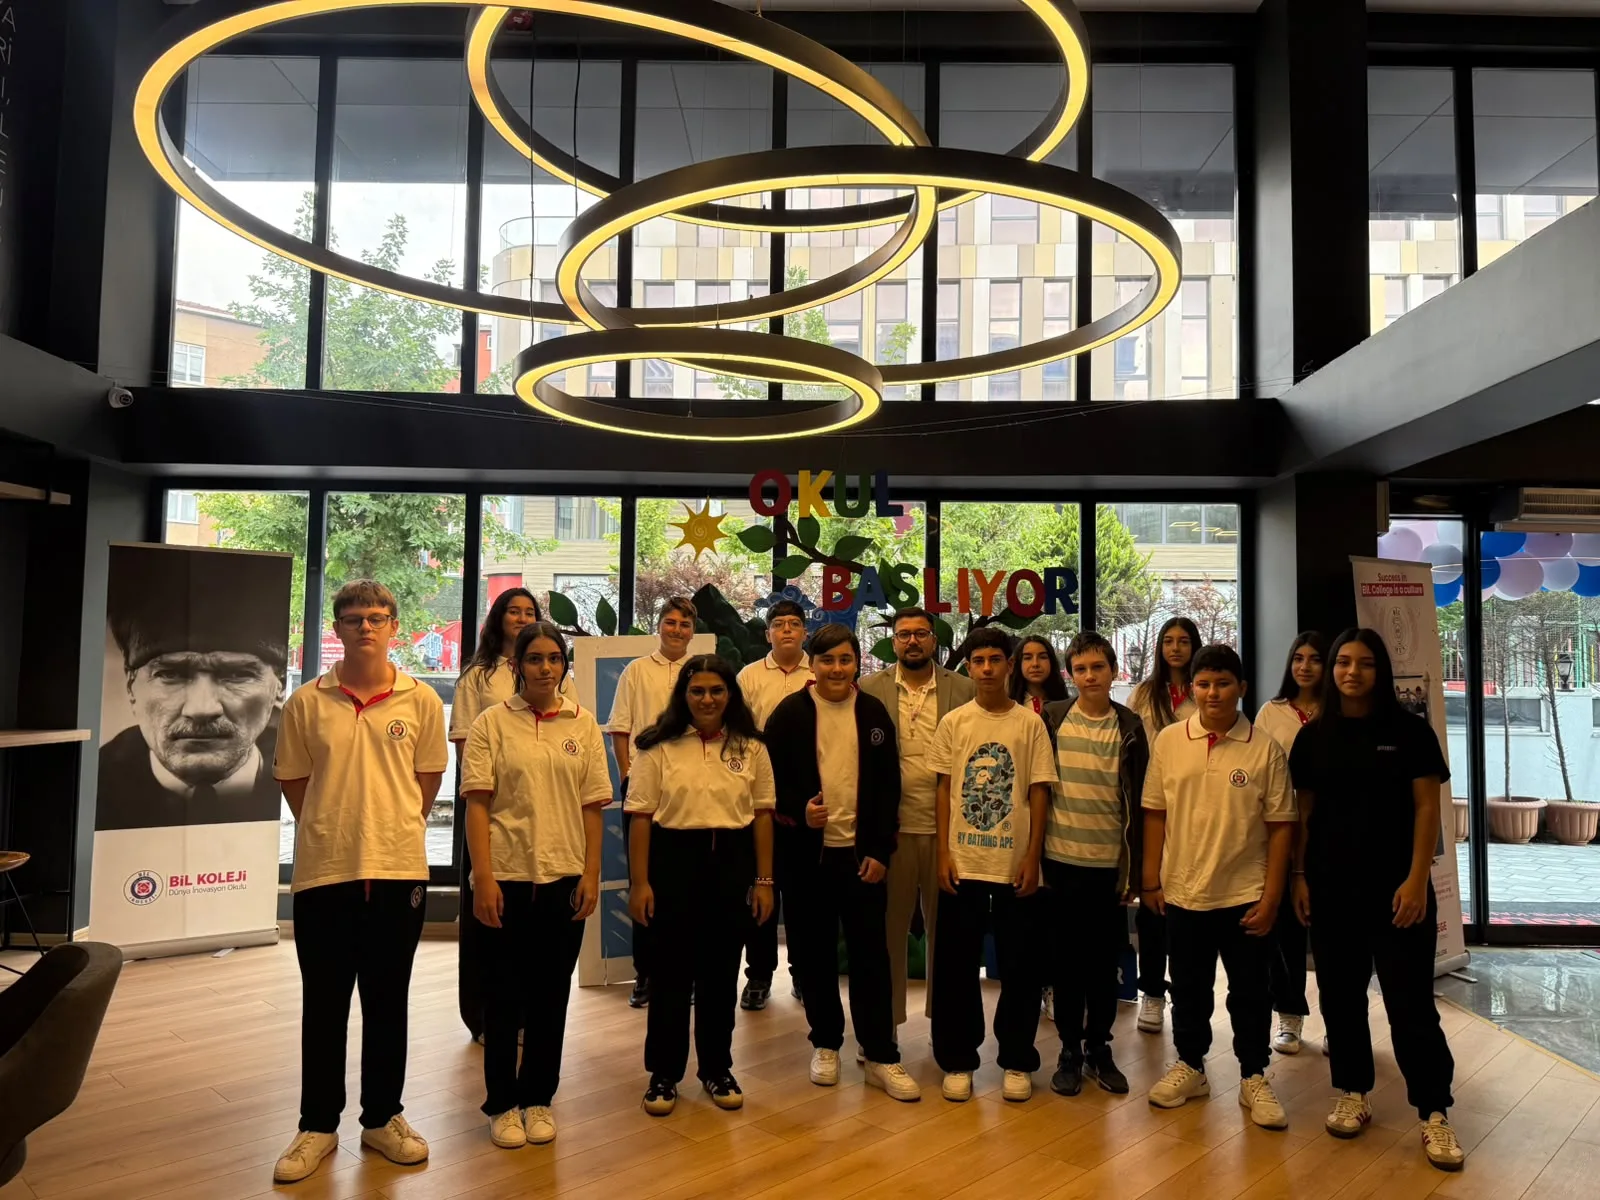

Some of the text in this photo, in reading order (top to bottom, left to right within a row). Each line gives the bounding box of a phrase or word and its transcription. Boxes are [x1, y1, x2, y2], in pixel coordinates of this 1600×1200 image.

[749, 469, 904, 518] OKUL
[1377, 573, 1400, 582] Success
[1372, 585, 1393, 597] College
[967, 832, 998, 848] BATHING
[999, 836, 1014, 849] APE
[168, 888, 191, 896] Dünya
[227, 883, 247, 891] Okulu
